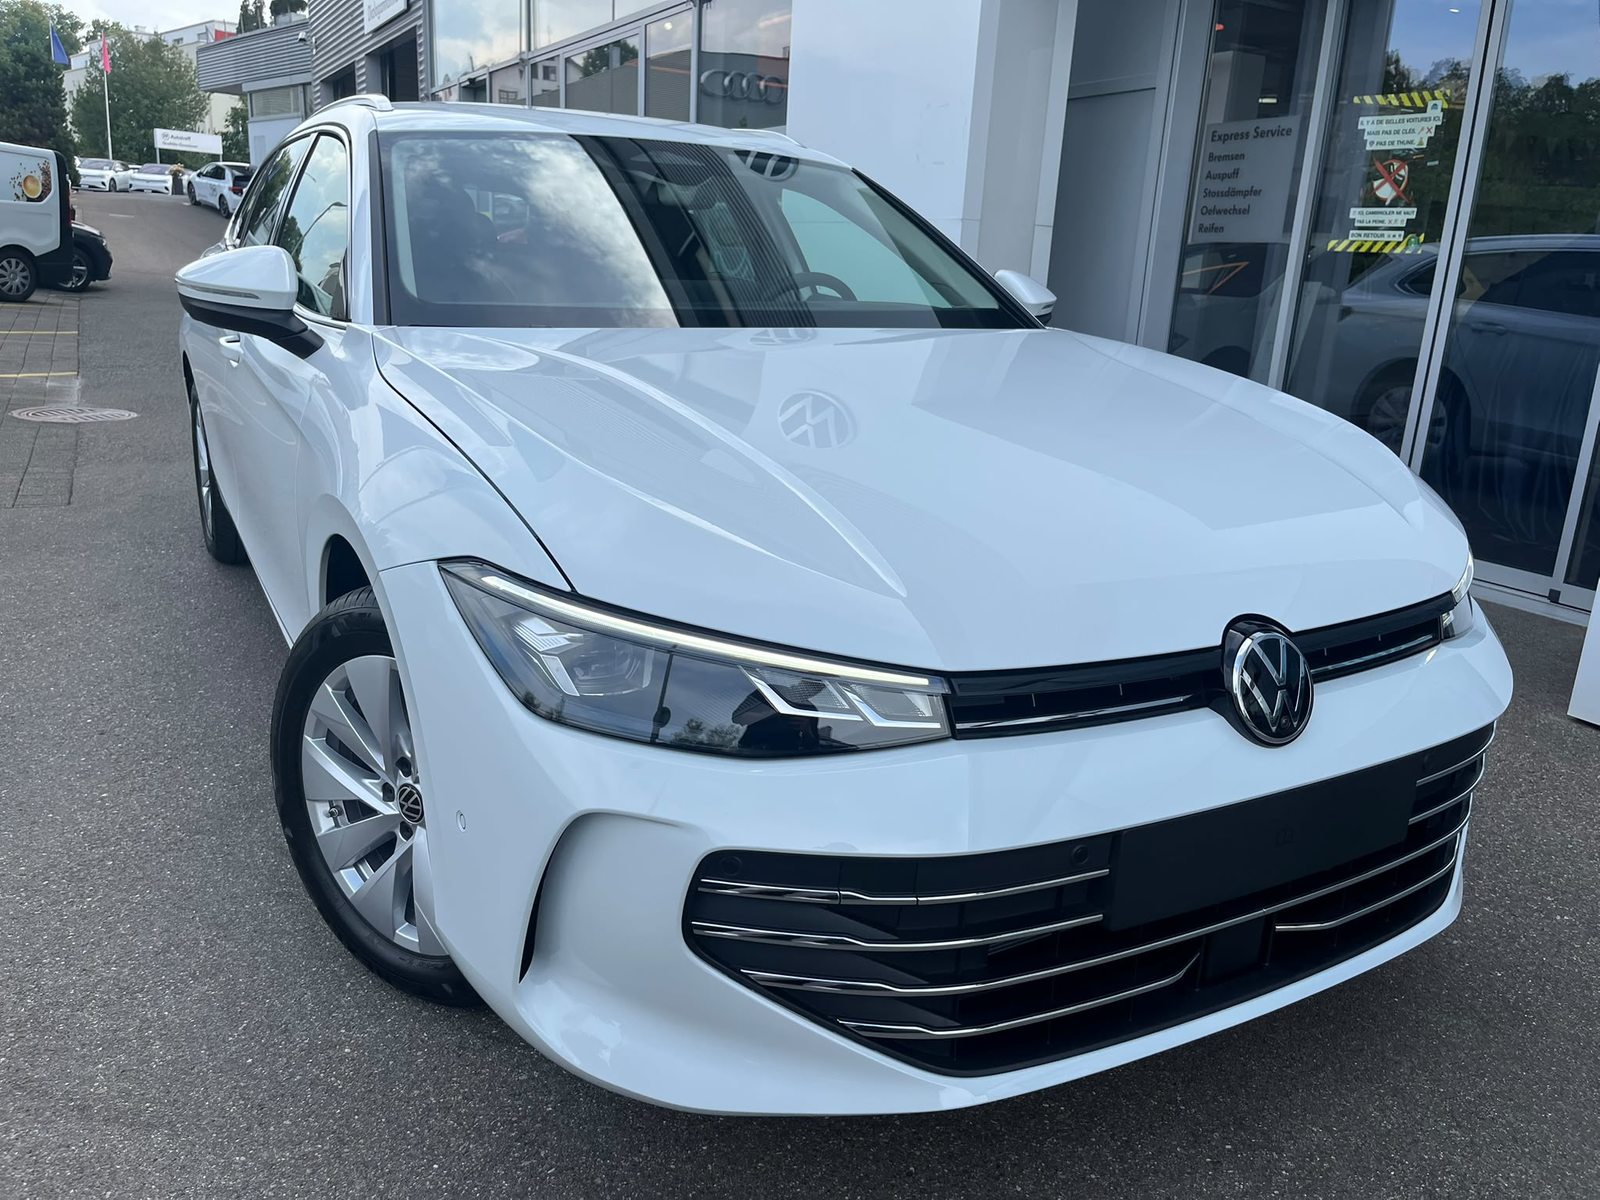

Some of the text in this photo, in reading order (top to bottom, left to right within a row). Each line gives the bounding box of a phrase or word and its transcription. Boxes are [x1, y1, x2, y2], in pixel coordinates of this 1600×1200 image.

[1385, 117, 1405, 125] BELLES
[1211, 125, 1292, 144] Express Service
[1208, 152, 1245, 162] Bremsen
[1206, 168, 1240, 181] Auspuff
[1203, 185, 1262, 199] Stossdämpfer
[1201, 204, 1250, 216] Oelwechsel
[1198, 222, 1224, 233] Reifen
